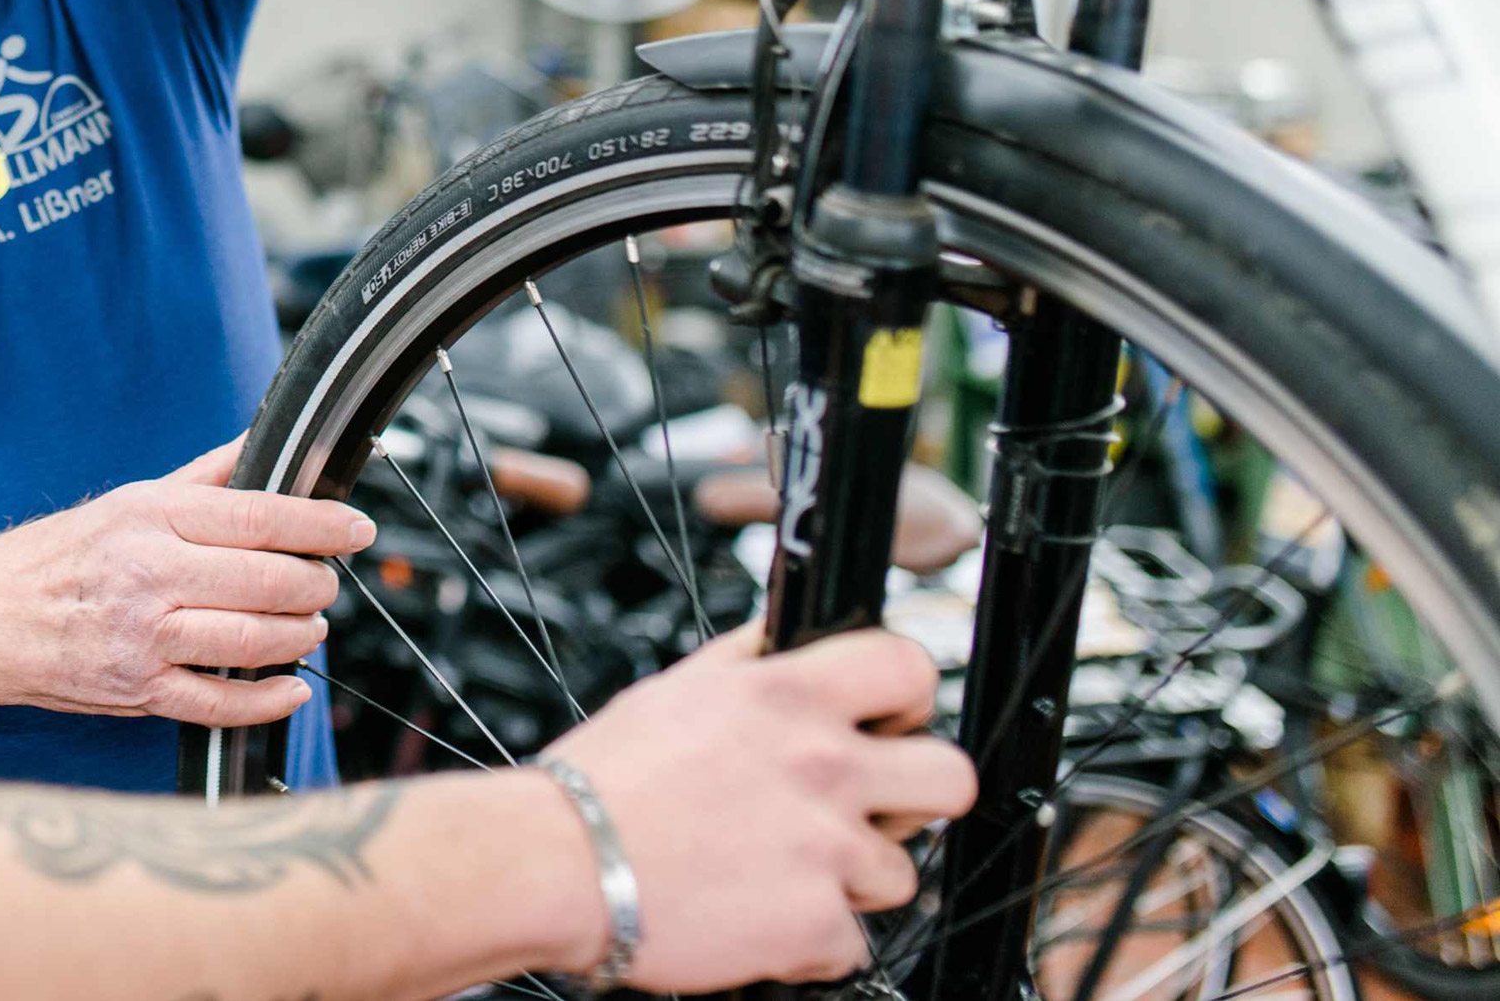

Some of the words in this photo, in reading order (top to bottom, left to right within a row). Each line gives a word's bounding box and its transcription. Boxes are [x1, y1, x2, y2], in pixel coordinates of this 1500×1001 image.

[18, 170, 114, 233] Lißner
[430, 202, 470, 238] E-BIKE
[393, 233, 428, 271] READY
